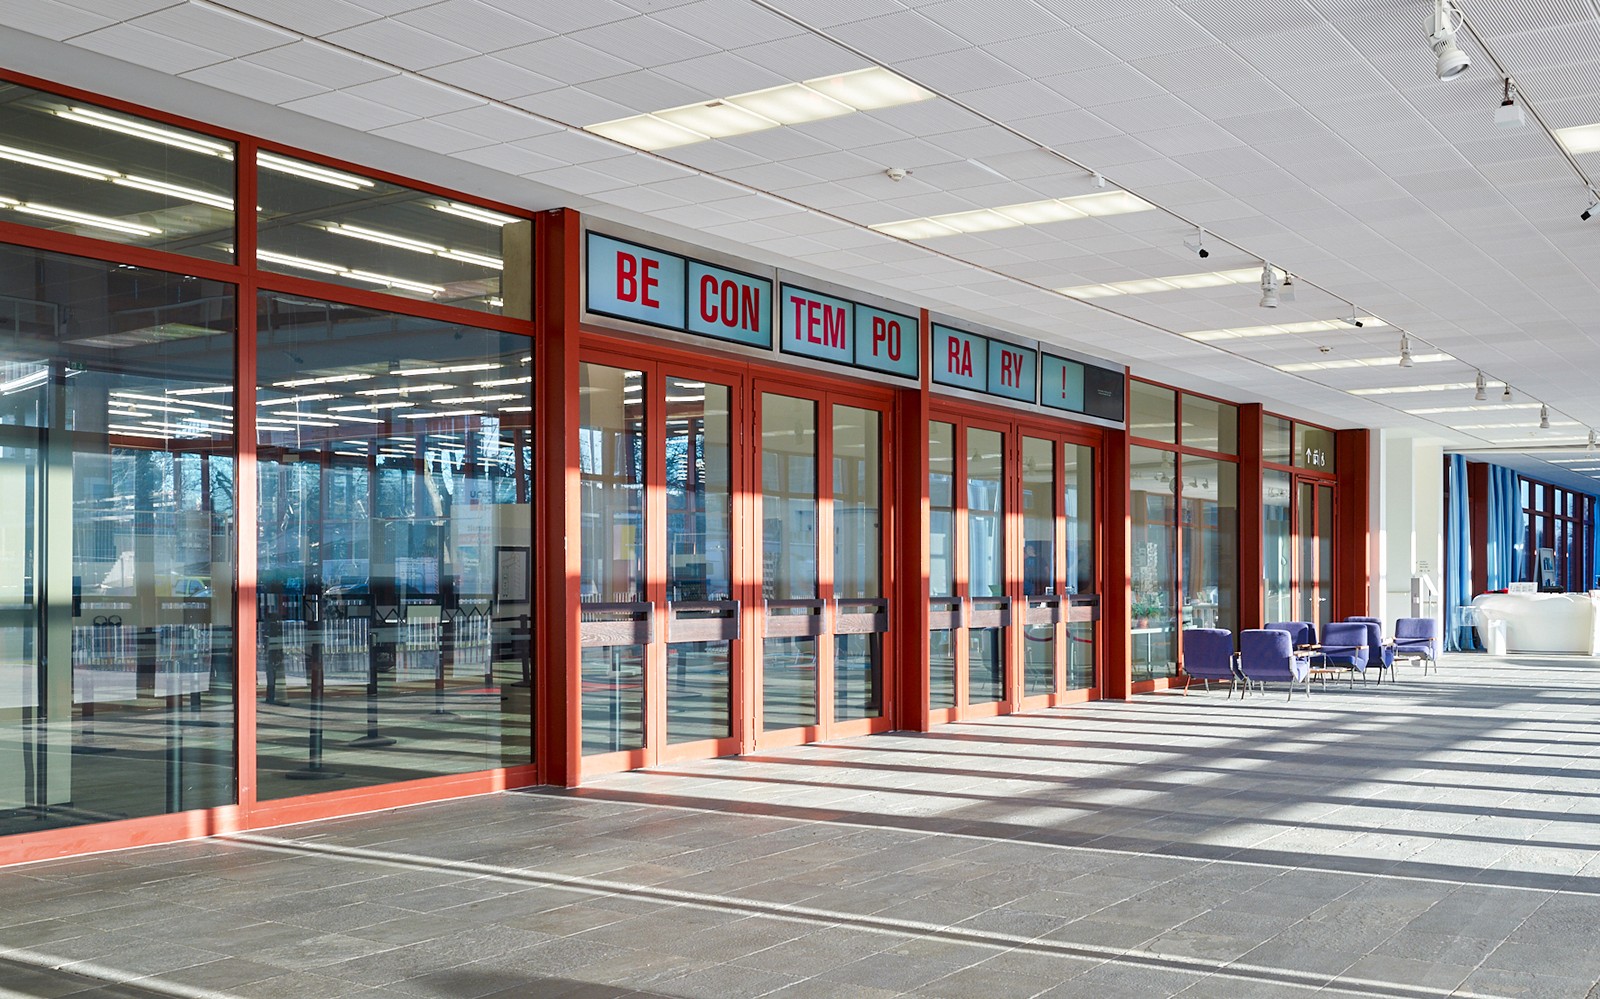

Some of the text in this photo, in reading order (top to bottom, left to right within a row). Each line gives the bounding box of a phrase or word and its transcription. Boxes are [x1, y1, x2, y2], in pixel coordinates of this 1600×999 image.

[617, 252, 659, 308] BE
[701, 275, 759, 331] CON
[791, 296, 845, 348] TEM
[873, 317, 901, 360] PO
[947, 337, 973, 377] RA
[1001, 351, 1023, 388] RY
